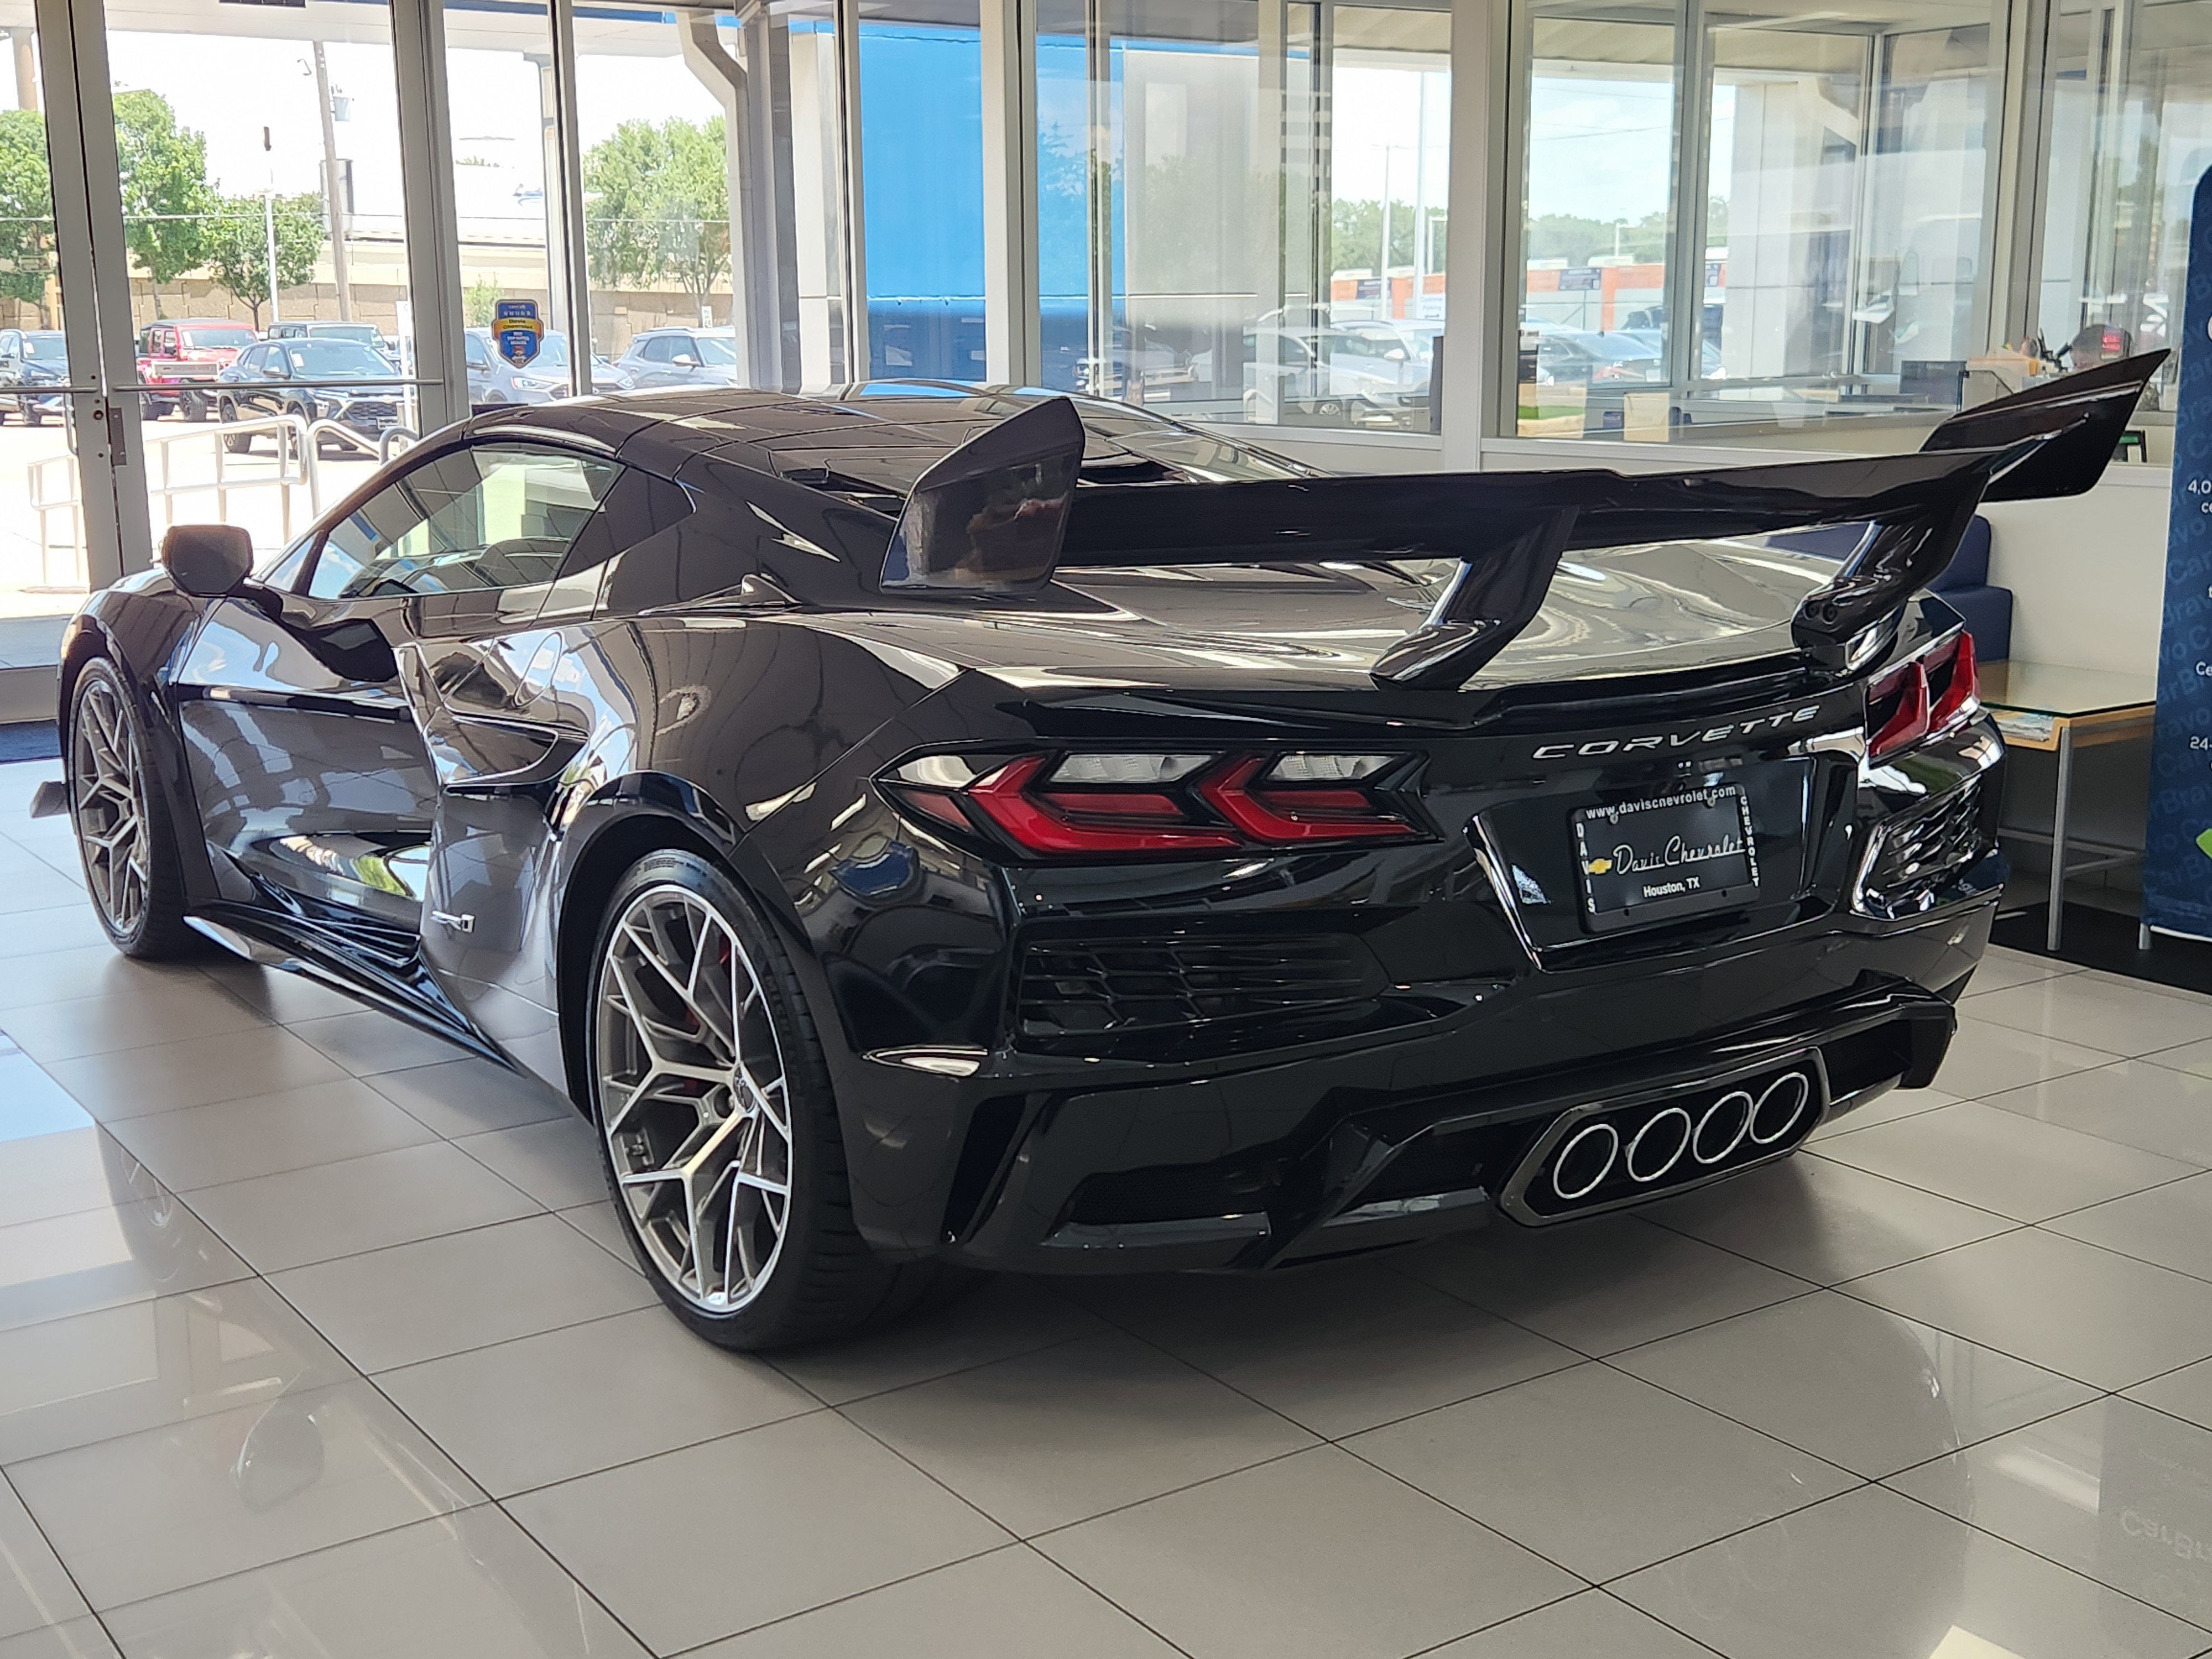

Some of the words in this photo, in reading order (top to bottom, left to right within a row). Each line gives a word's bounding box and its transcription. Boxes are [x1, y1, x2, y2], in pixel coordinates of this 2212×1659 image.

[1532, 705, 1820, 759] CORVETTE
[1576, 822, 1596, 913] DAVIS
[1613, 844, 1666, 874] Davis
[1664, 834, 1746, 866] Chevrolet
[1740, 795, 1759, 887] CHEVROLET
[1643, 882, 1686, 898] Houston,
[1686, 877, 1700, 889] TX
